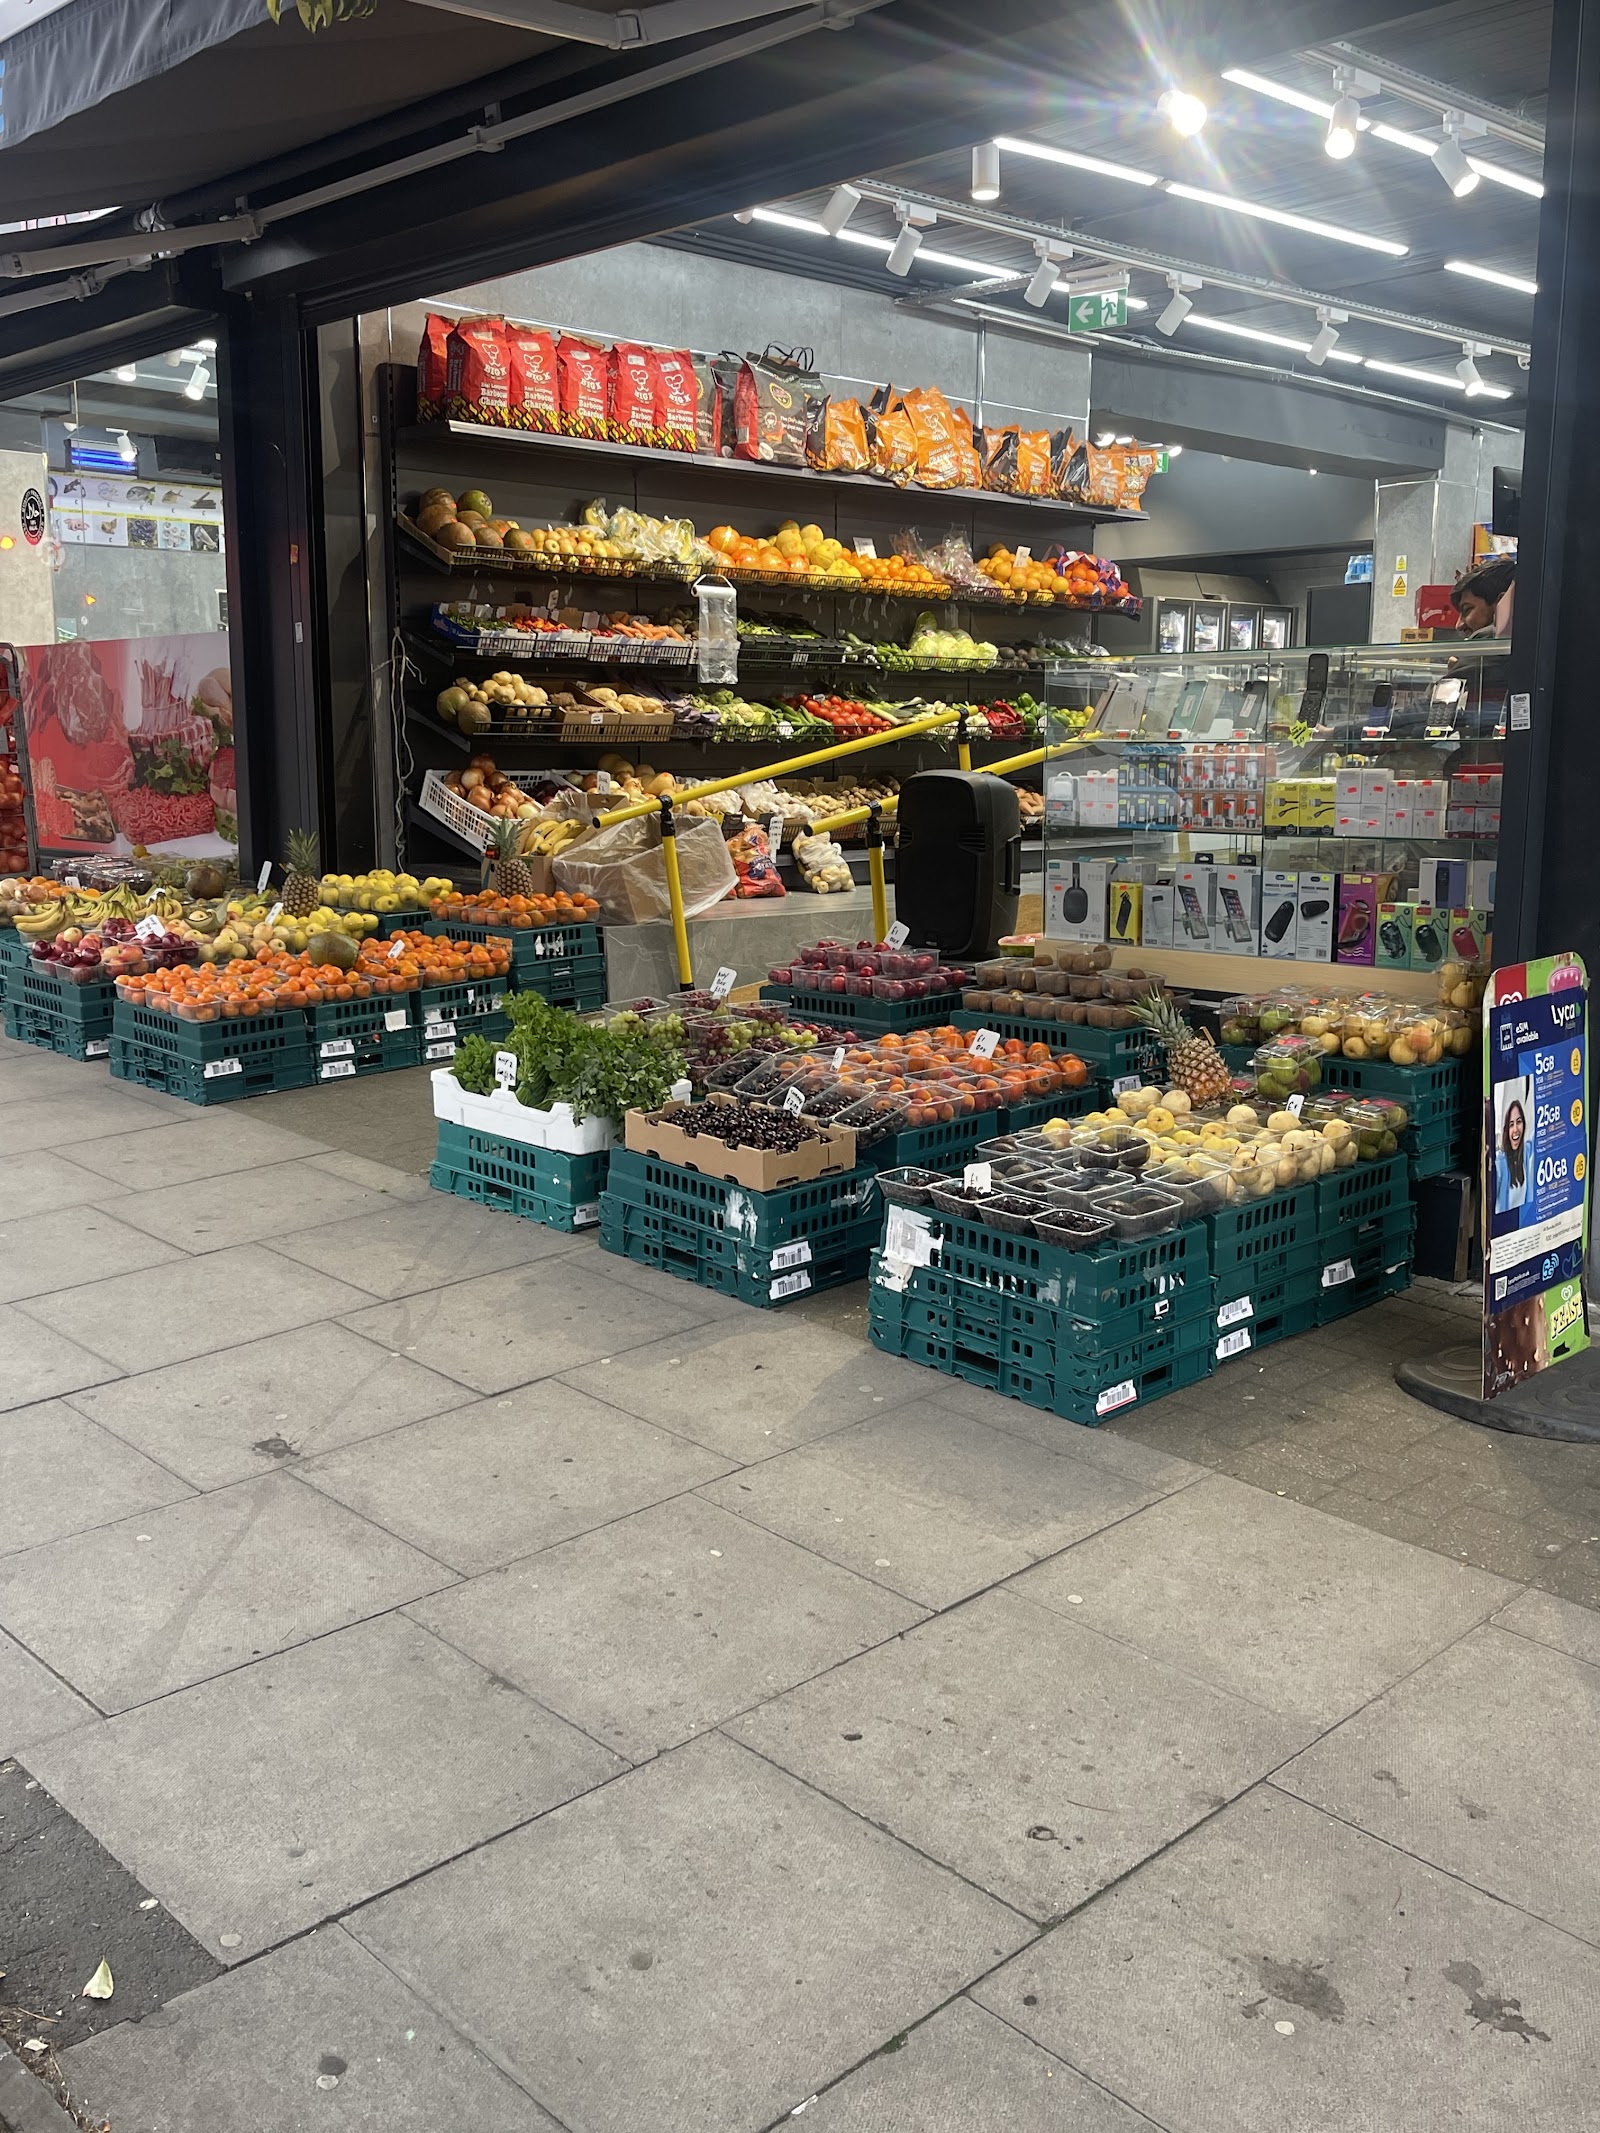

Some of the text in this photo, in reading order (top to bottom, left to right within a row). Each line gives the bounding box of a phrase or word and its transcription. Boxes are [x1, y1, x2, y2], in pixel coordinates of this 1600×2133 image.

[1550, 1002, 1575, 1026] Lyca
[1516, 1022, 1529, 1032] eSIM
[1516, 1030, 1539, 1044] available
[1535, 1052, 1554, 1074] 5GB
[1536, 1104, 1560, 1128] 25GB
[1536, 1156, 1568, 1186] 60GB
[1551, 1292, 1583, 1340] FEAST
